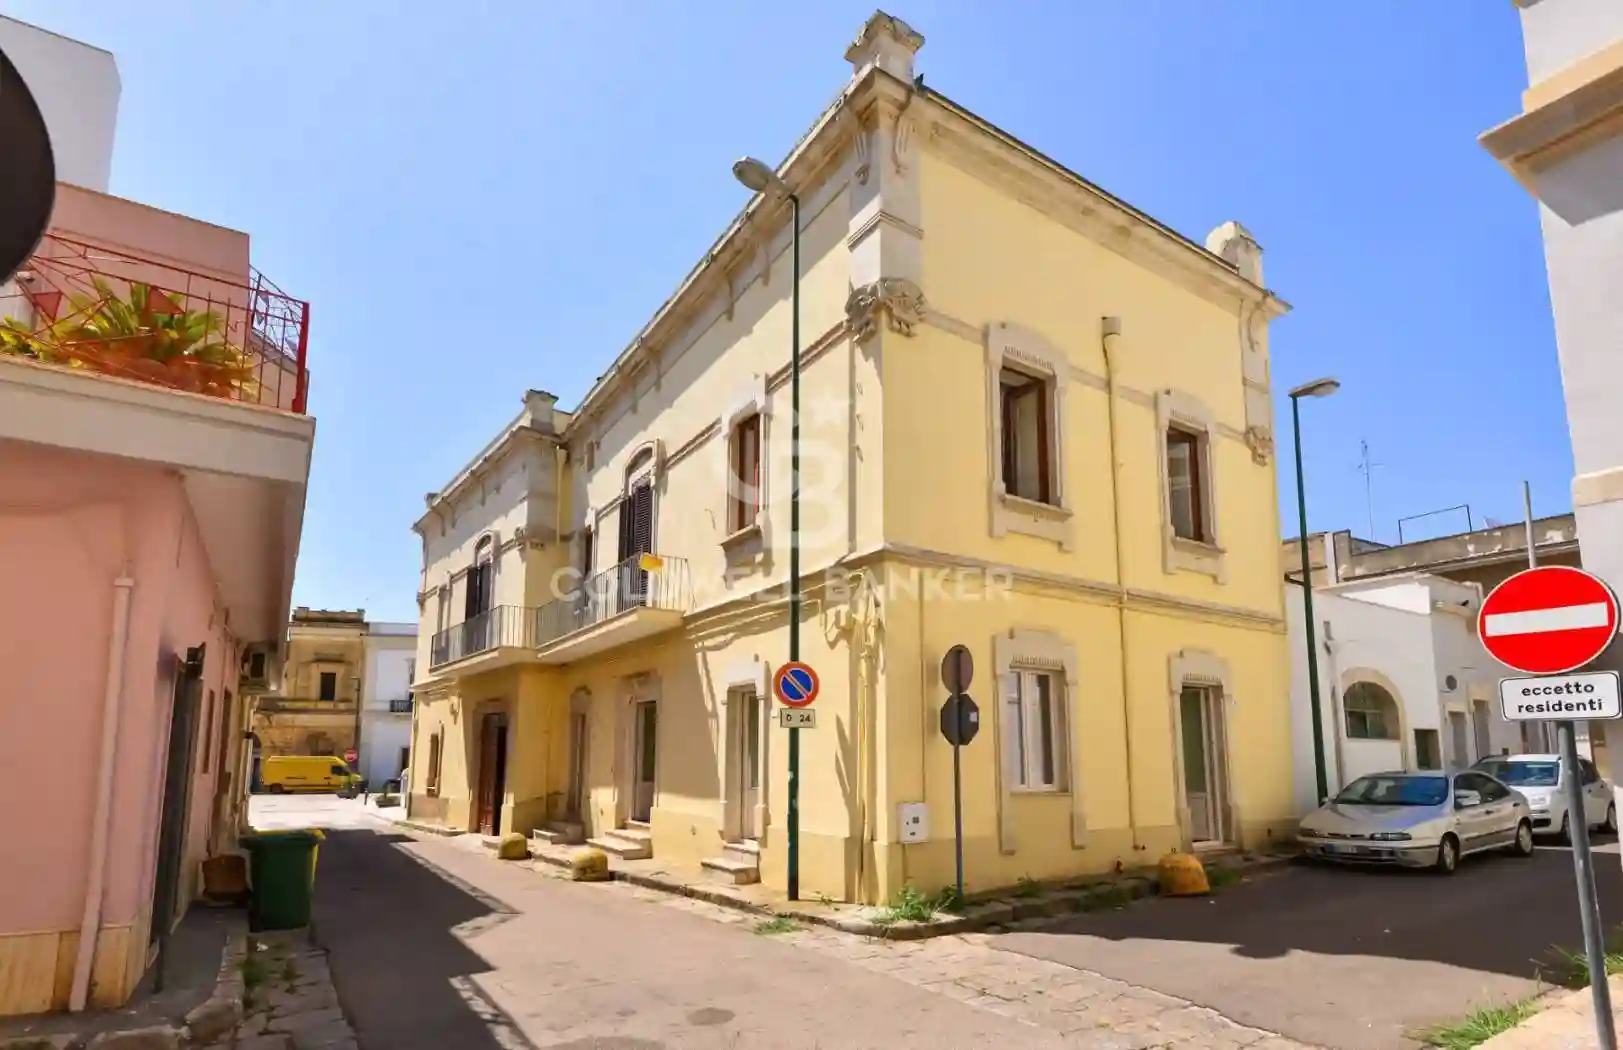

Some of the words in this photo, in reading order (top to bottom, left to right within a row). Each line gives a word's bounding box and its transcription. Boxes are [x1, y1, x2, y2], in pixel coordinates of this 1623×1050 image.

[1521, 682, 1594, 696] eccetto
[1518, 698, 1603, 713] residenti
[799, 714, 811, 722] 24
